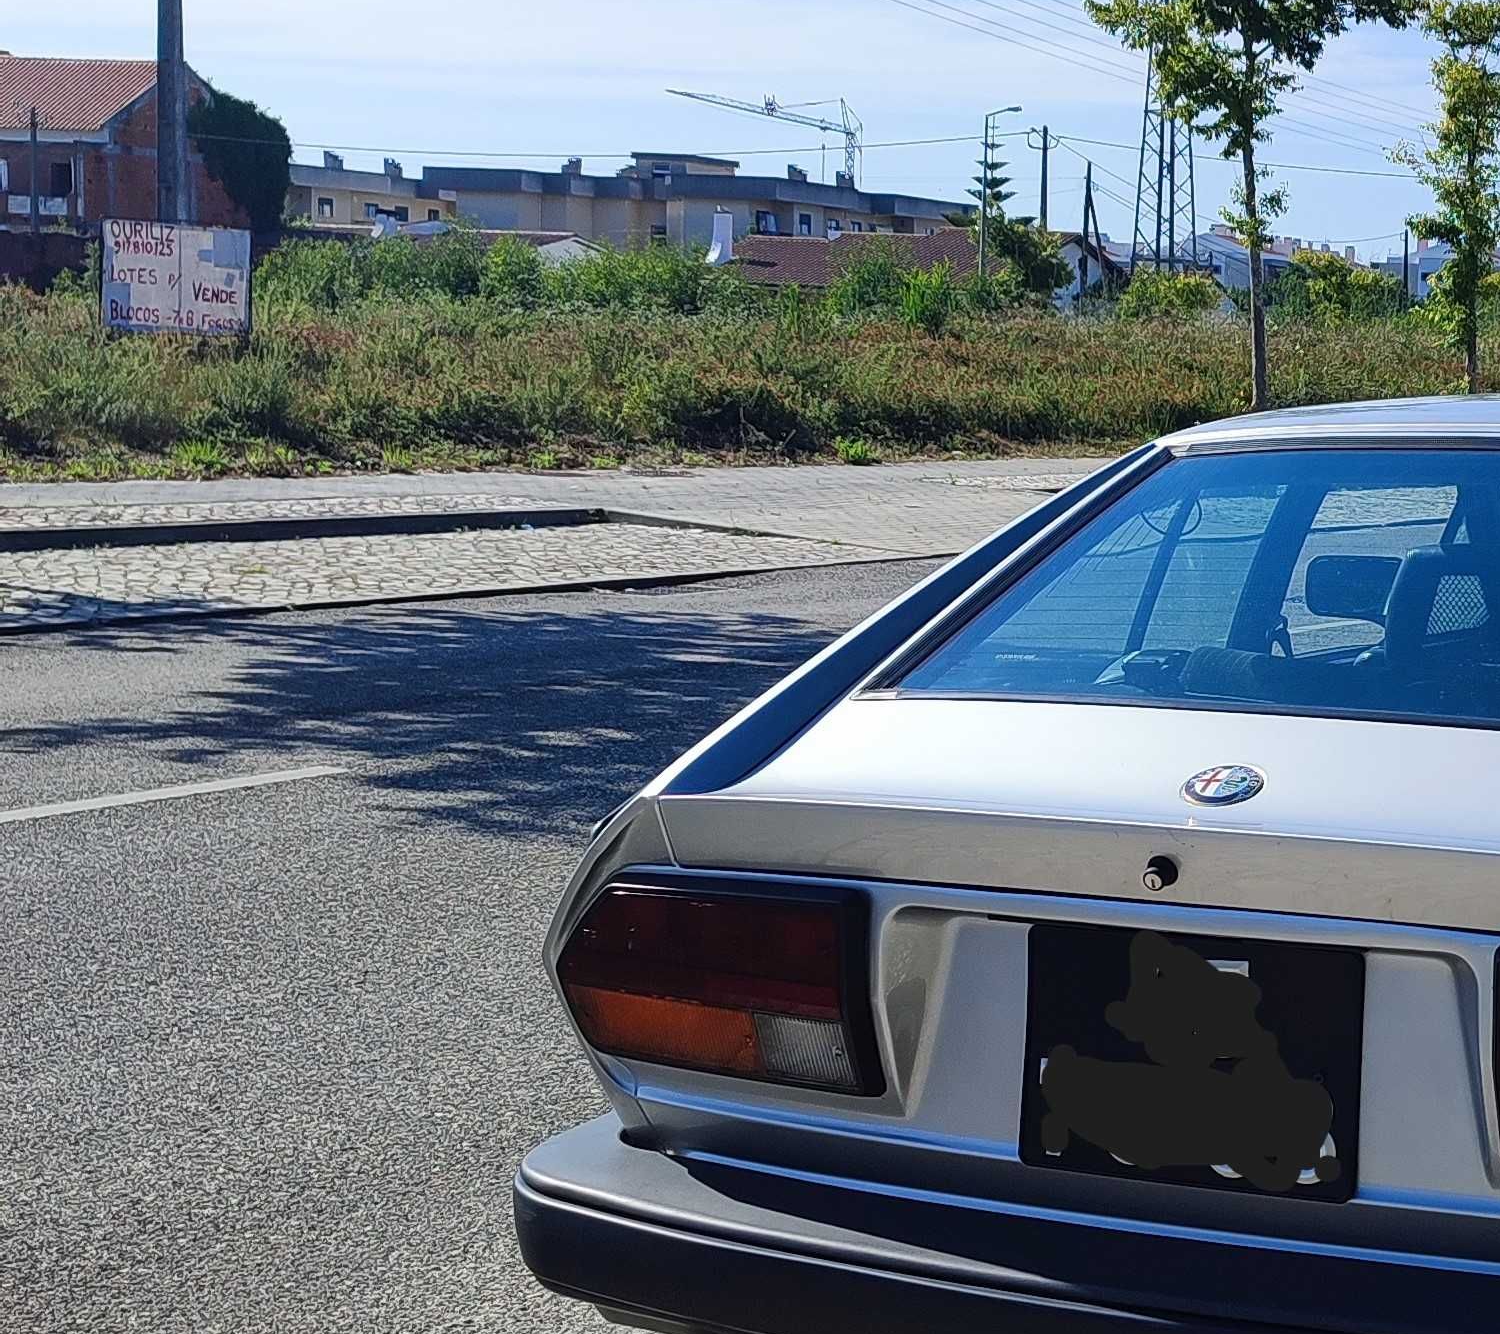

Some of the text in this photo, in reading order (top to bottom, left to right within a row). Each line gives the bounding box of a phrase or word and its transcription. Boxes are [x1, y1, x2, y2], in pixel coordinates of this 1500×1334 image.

[111, 220, 175, 243] OURILIZ
[110, 264, 158, 286] LOTES
[193, 281, 238, 305] VENDE
[110, 298, 160, 324] BLOCOS
